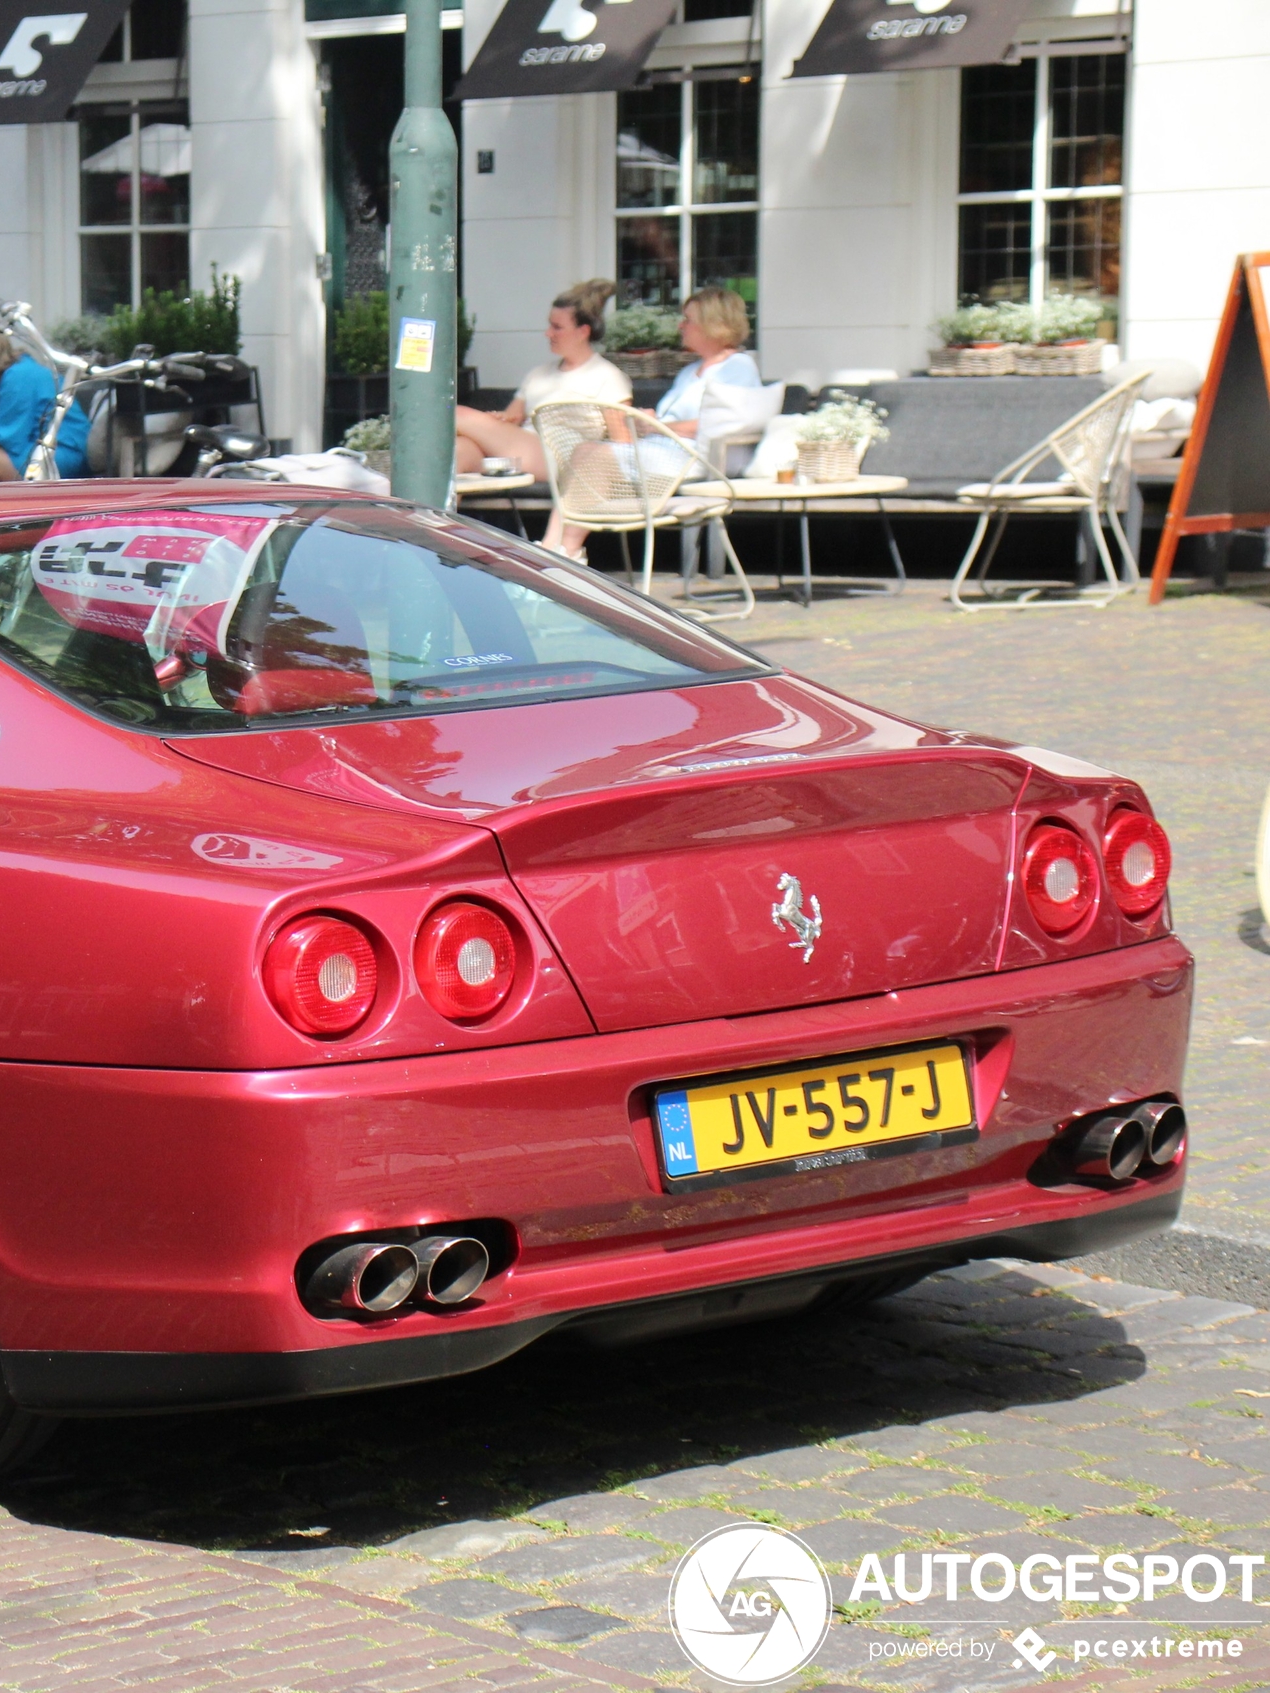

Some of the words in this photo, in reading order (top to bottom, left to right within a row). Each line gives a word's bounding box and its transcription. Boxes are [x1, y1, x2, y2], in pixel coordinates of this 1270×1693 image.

[866, 14, 968, 40] saranne
[518, 43, 606, 67] saranne
[723, 1060, 942, 1155] JV-557-J
[668, 1142, 693, 1162] NL
